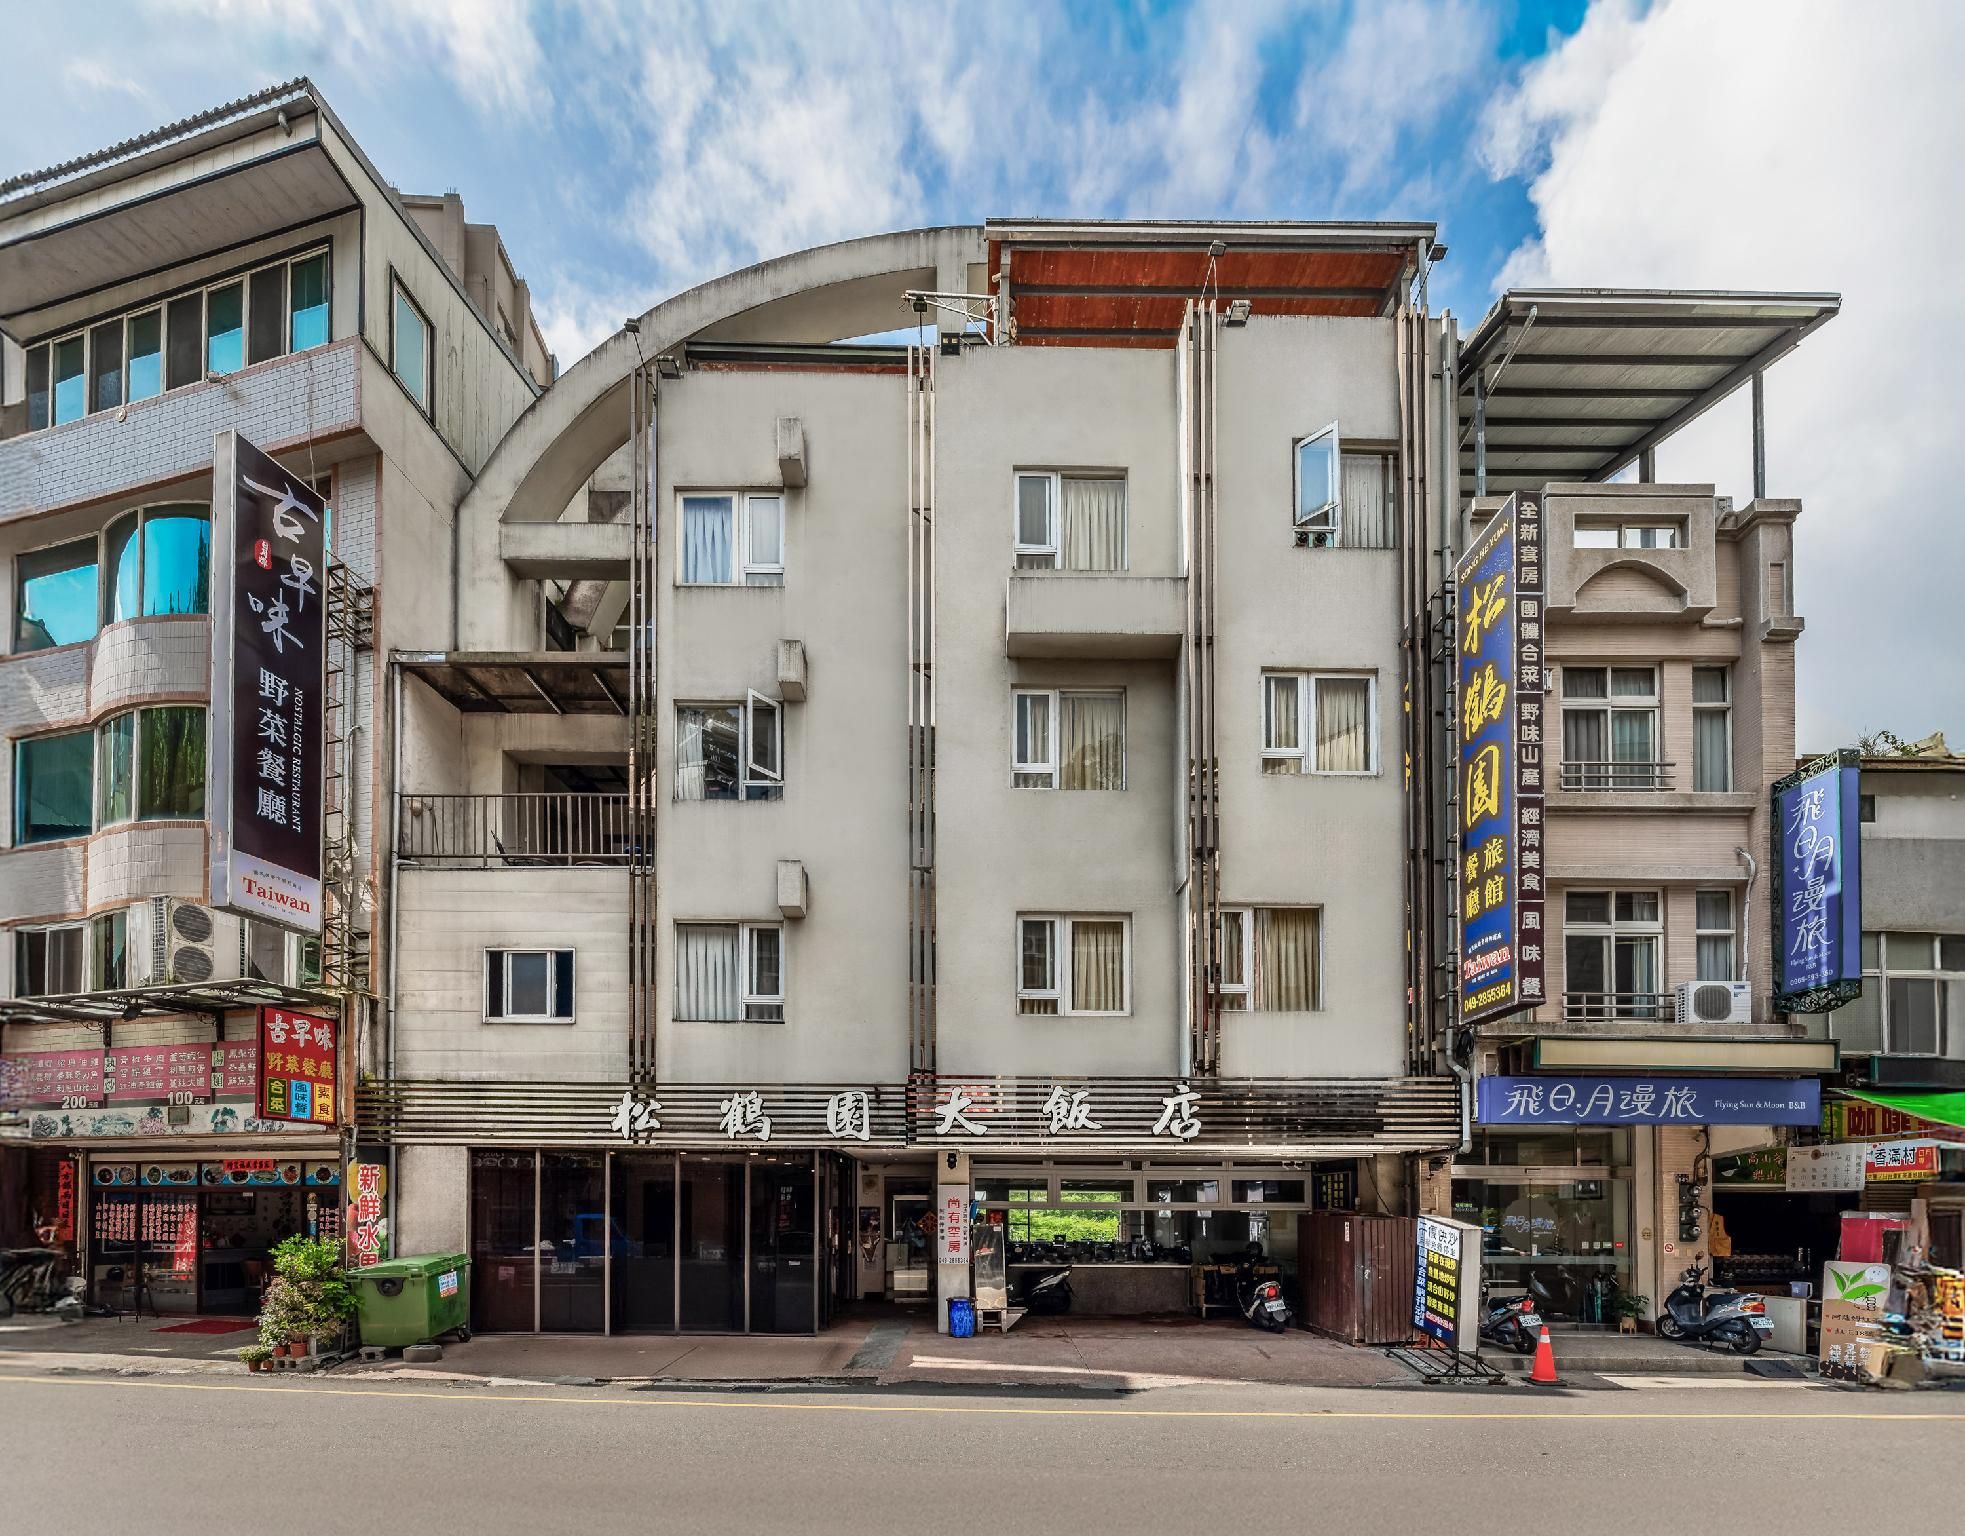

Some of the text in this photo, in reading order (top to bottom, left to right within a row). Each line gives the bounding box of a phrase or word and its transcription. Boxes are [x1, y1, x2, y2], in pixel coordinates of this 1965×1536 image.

[243, 474, 319, 654] 古早味
[1460, 519, 1510, 584] SONG HE YUAN
[1519, 501, 1539, 585] 全新套房
[1520, 600, 1540, 684] 團體合菜
[1464, 574, 1507, 829] 松鶴園
[256, 666, 289, 825] 野菜餐廳
[292, 687, 304, 833] NOSTALGIC RESTAURANT
[1521, 703, 1540, 787] 野味山產
[1484, 838, 1505, 910] 旅館
[1521, 807, 1541, 892] 經濟美食
[242, 876, 311, 914] Taiwan
[1465, 852, 1480, 922] 餐廳
[1521, 911, 1541, 996] 風味餐
[1464, 981, 1511, 1013] 049-2855364
[267, 1013, 334, 1052] 古早味
[267, 1052, 334, 1080] 野菜餐廳
[271, 1081, 285, 1111] 合菜
[62, 1095, 87, 1108] 200
[167, 1091, 193, 1105] 100
[318, 1086, 330, 1115] 素食
[608, 1084, 1202, 1142] 松鶴園大飯店
[1714, 1099, 1806, 1111] Flying Sun & Moon B&B
[1874, 1147, 1917, 1166] 香滿村
[947, 1197, 961, 1253] 尚有空房
